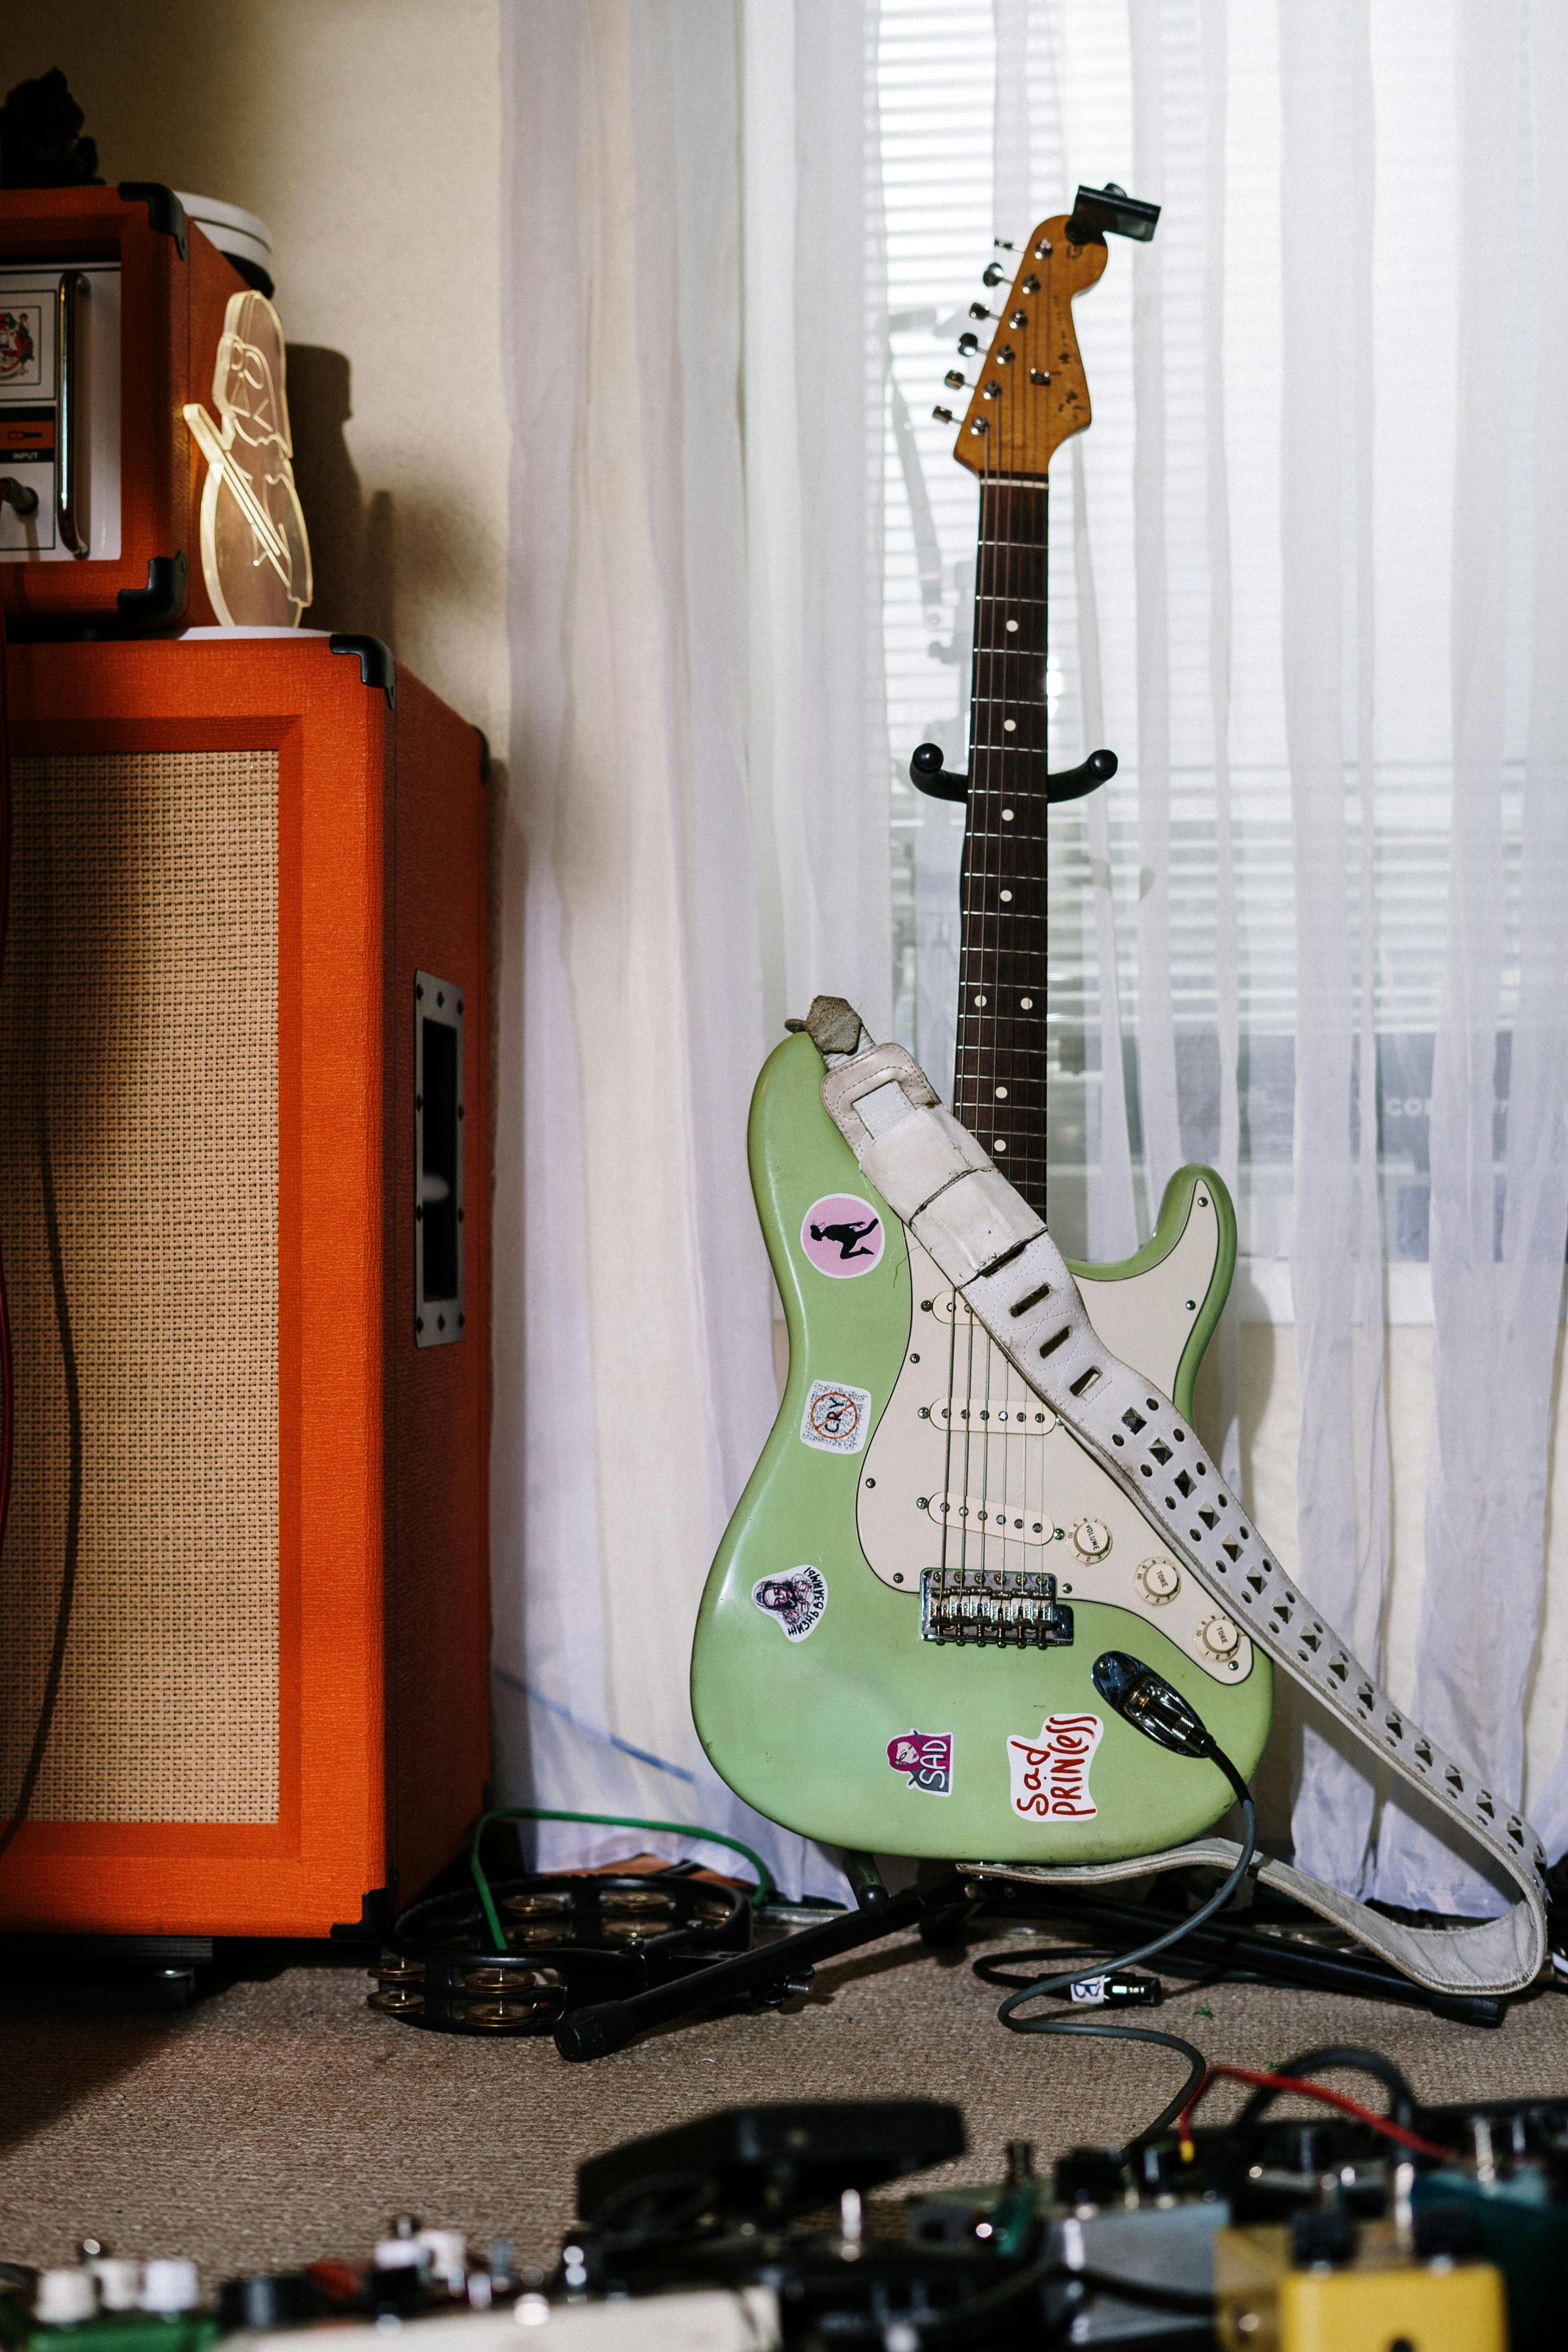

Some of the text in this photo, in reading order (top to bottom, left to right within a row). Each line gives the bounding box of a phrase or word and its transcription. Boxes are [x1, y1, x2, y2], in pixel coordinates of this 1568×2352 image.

[825, 1397, 844, 1433] CRY
[1086, 1523, 1100, 1551] VOLUME
[1156, 1570, 1168, 1588] TONE
[788, 1611, 819, 1636] ЖИЗНЬ
[1217, 1626, 1228, 1644] TONE
[919, 1740, 947, 1789] SAD
[1011, 1741, 1050, 1816] Sad
